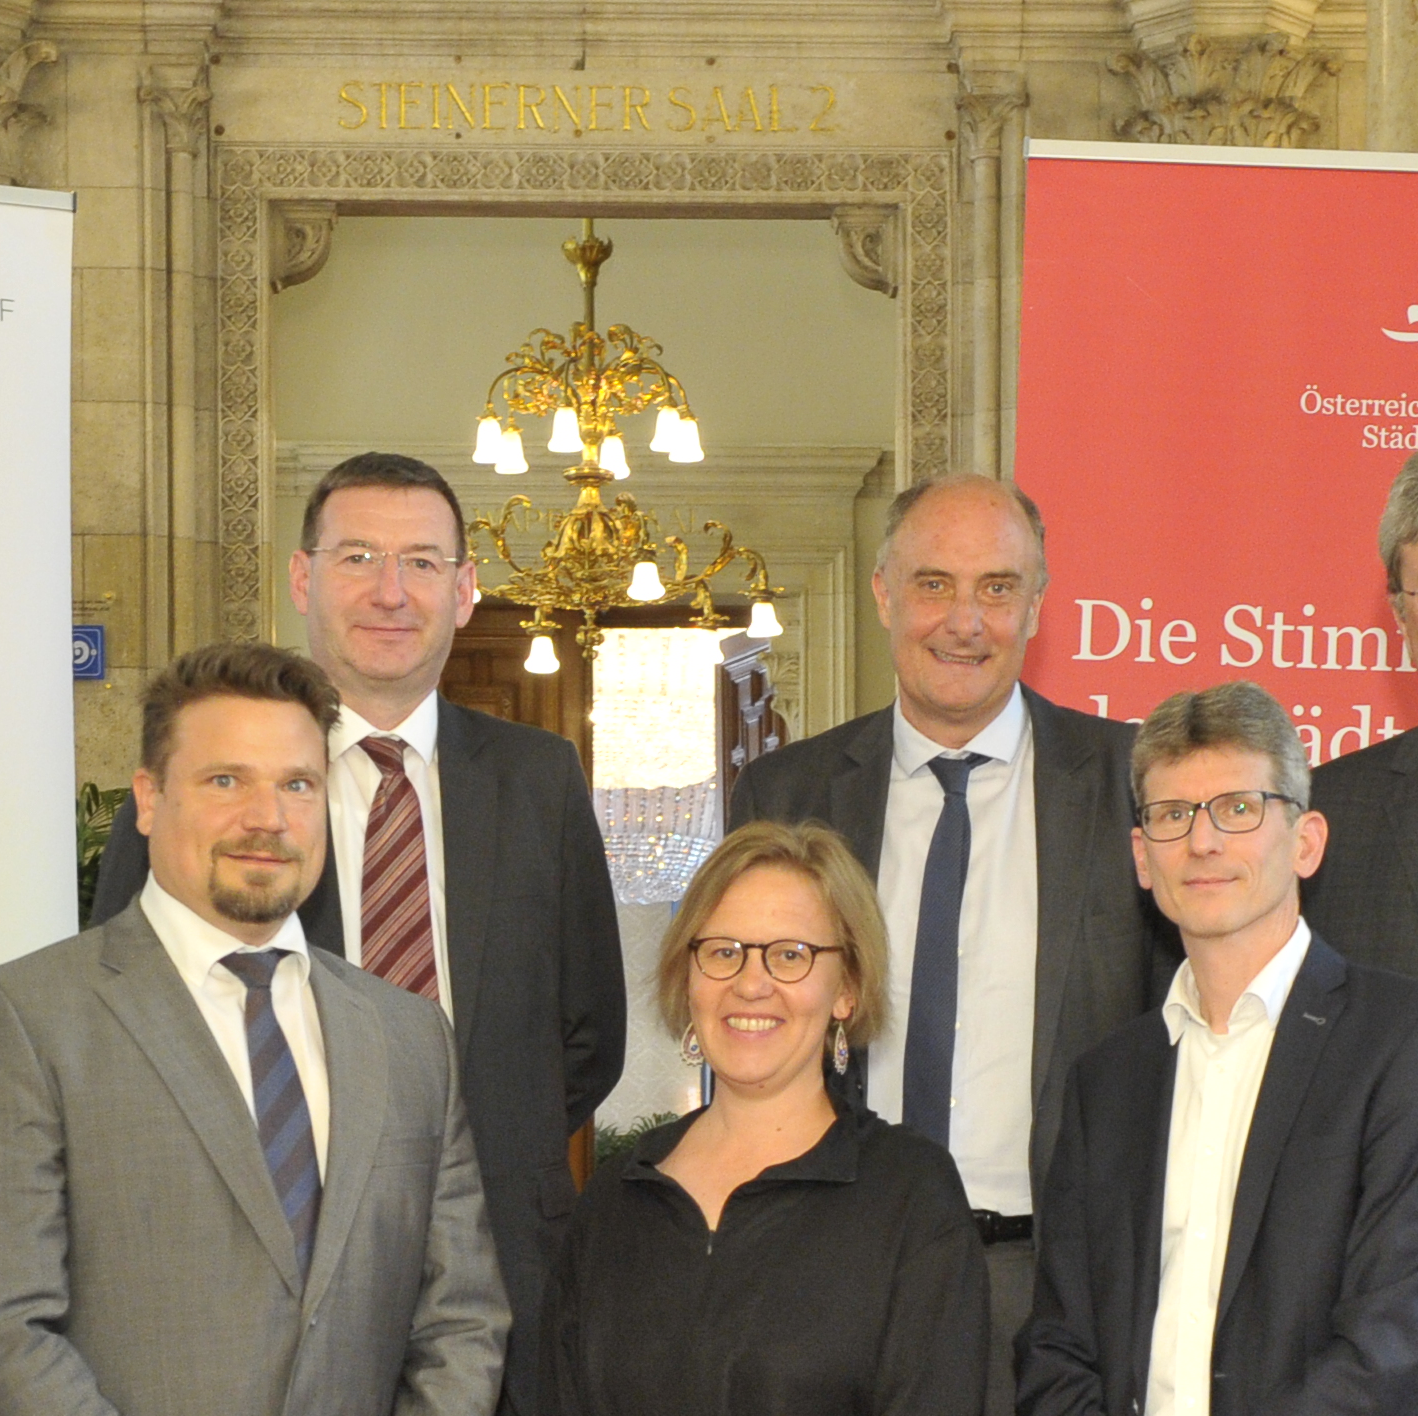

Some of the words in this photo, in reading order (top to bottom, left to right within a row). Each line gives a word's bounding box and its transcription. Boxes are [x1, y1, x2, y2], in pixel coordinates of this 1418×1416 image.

[338, 80, 652, 133] STEINERNER
[667, 84, 796, 132] SAAL
[807, 84, 843, 133] 2
[1072, 597, 1197, 665] Die
